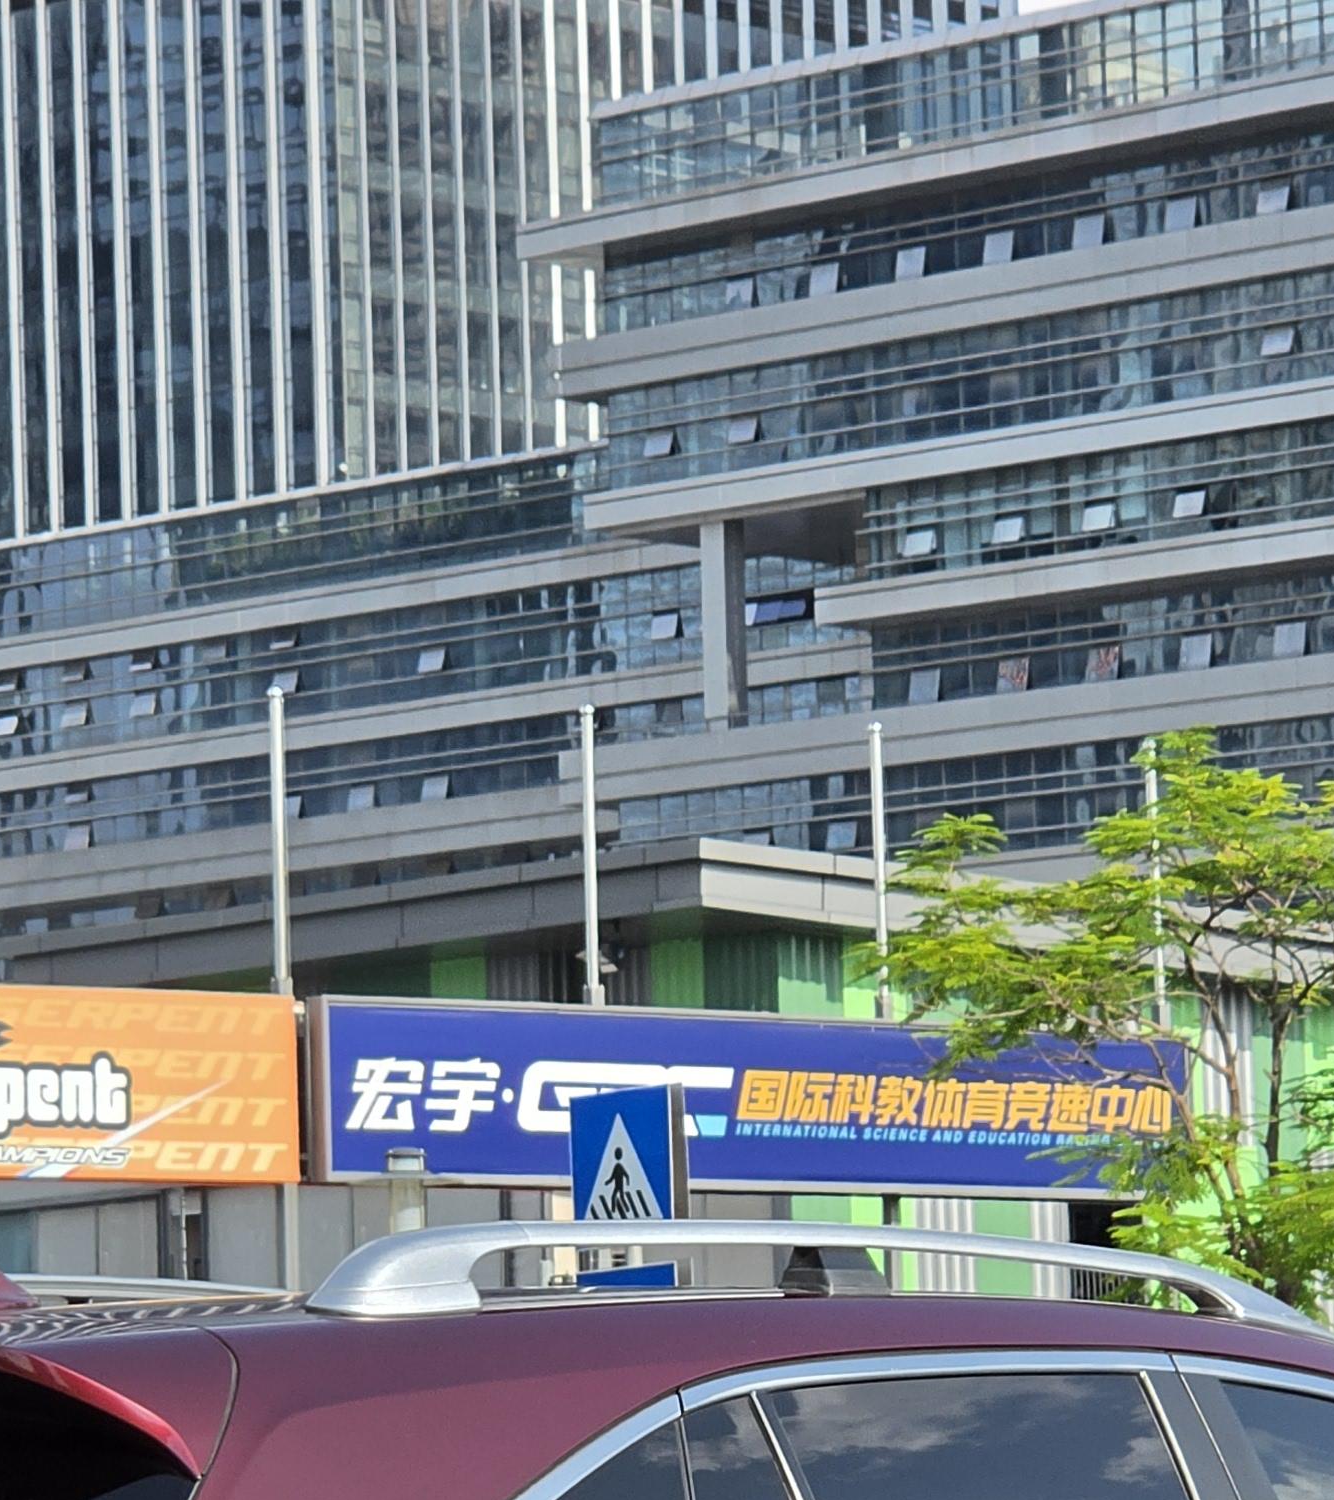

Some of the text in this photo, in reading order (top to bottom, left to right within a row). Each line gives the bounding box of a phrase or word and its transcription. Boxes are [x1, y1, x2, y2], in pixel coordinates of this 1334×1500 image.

[735, 1068, 1172, 1134] 国际科教体育竞速中心
[735, 1122, 858, 1140] INTERNATIONAL
[863, 1126, 928, 1142] SCIENCE
[932, 1129, 964, 1144] AND
[968, 1131, 1052, 1146] EDUCATION
